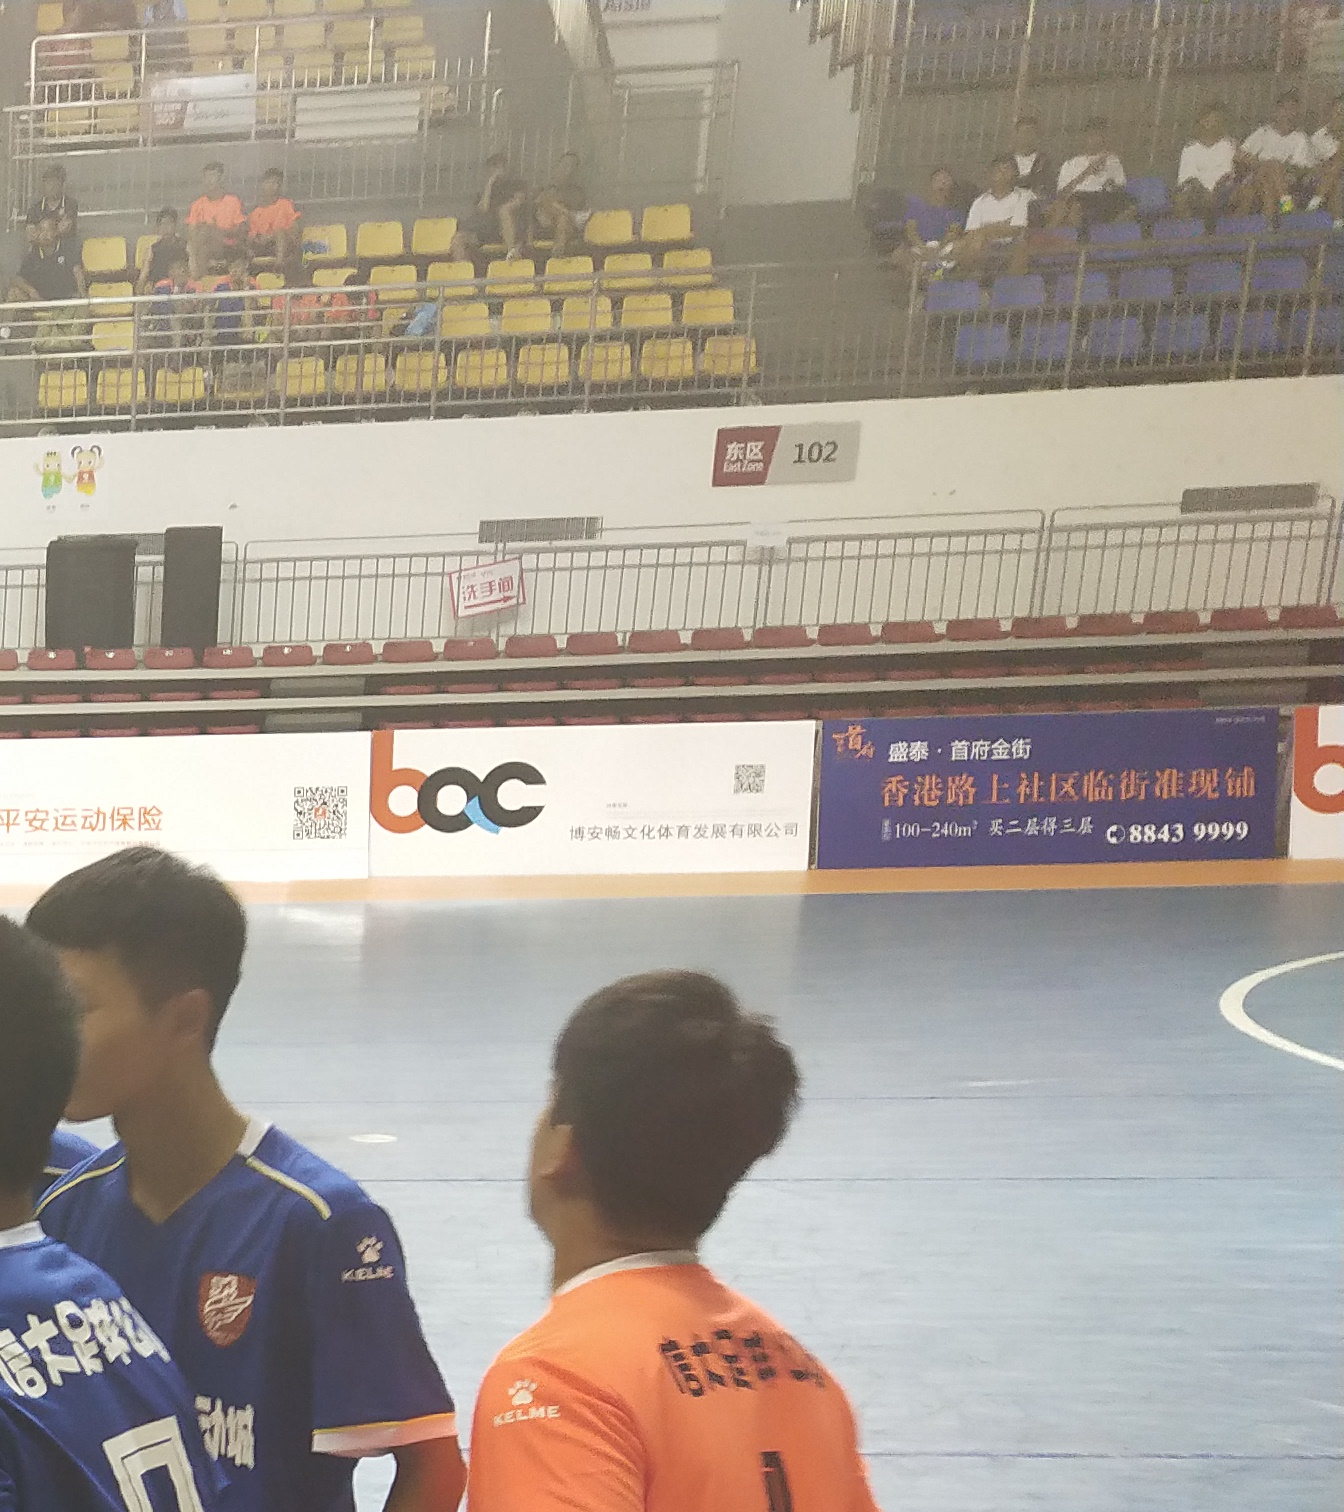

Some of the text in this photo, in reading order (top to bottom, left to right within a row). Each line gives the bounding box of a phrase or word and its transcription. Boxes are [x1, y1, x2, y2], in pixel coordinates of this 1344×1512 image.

[725, 440, 839, 463] 东区 102
[461, 575, 514, 601] 洗手间
[888, 738, 1032, 763] 盛泰·首府金街
[569, 822, 799, 842] 博安畅文化体育发展有限公司
[1128, 824, 1184, 843] 8843
[1193, 821, 1250, 842] 9999
[493, 1405, 561, 1427] KELME
